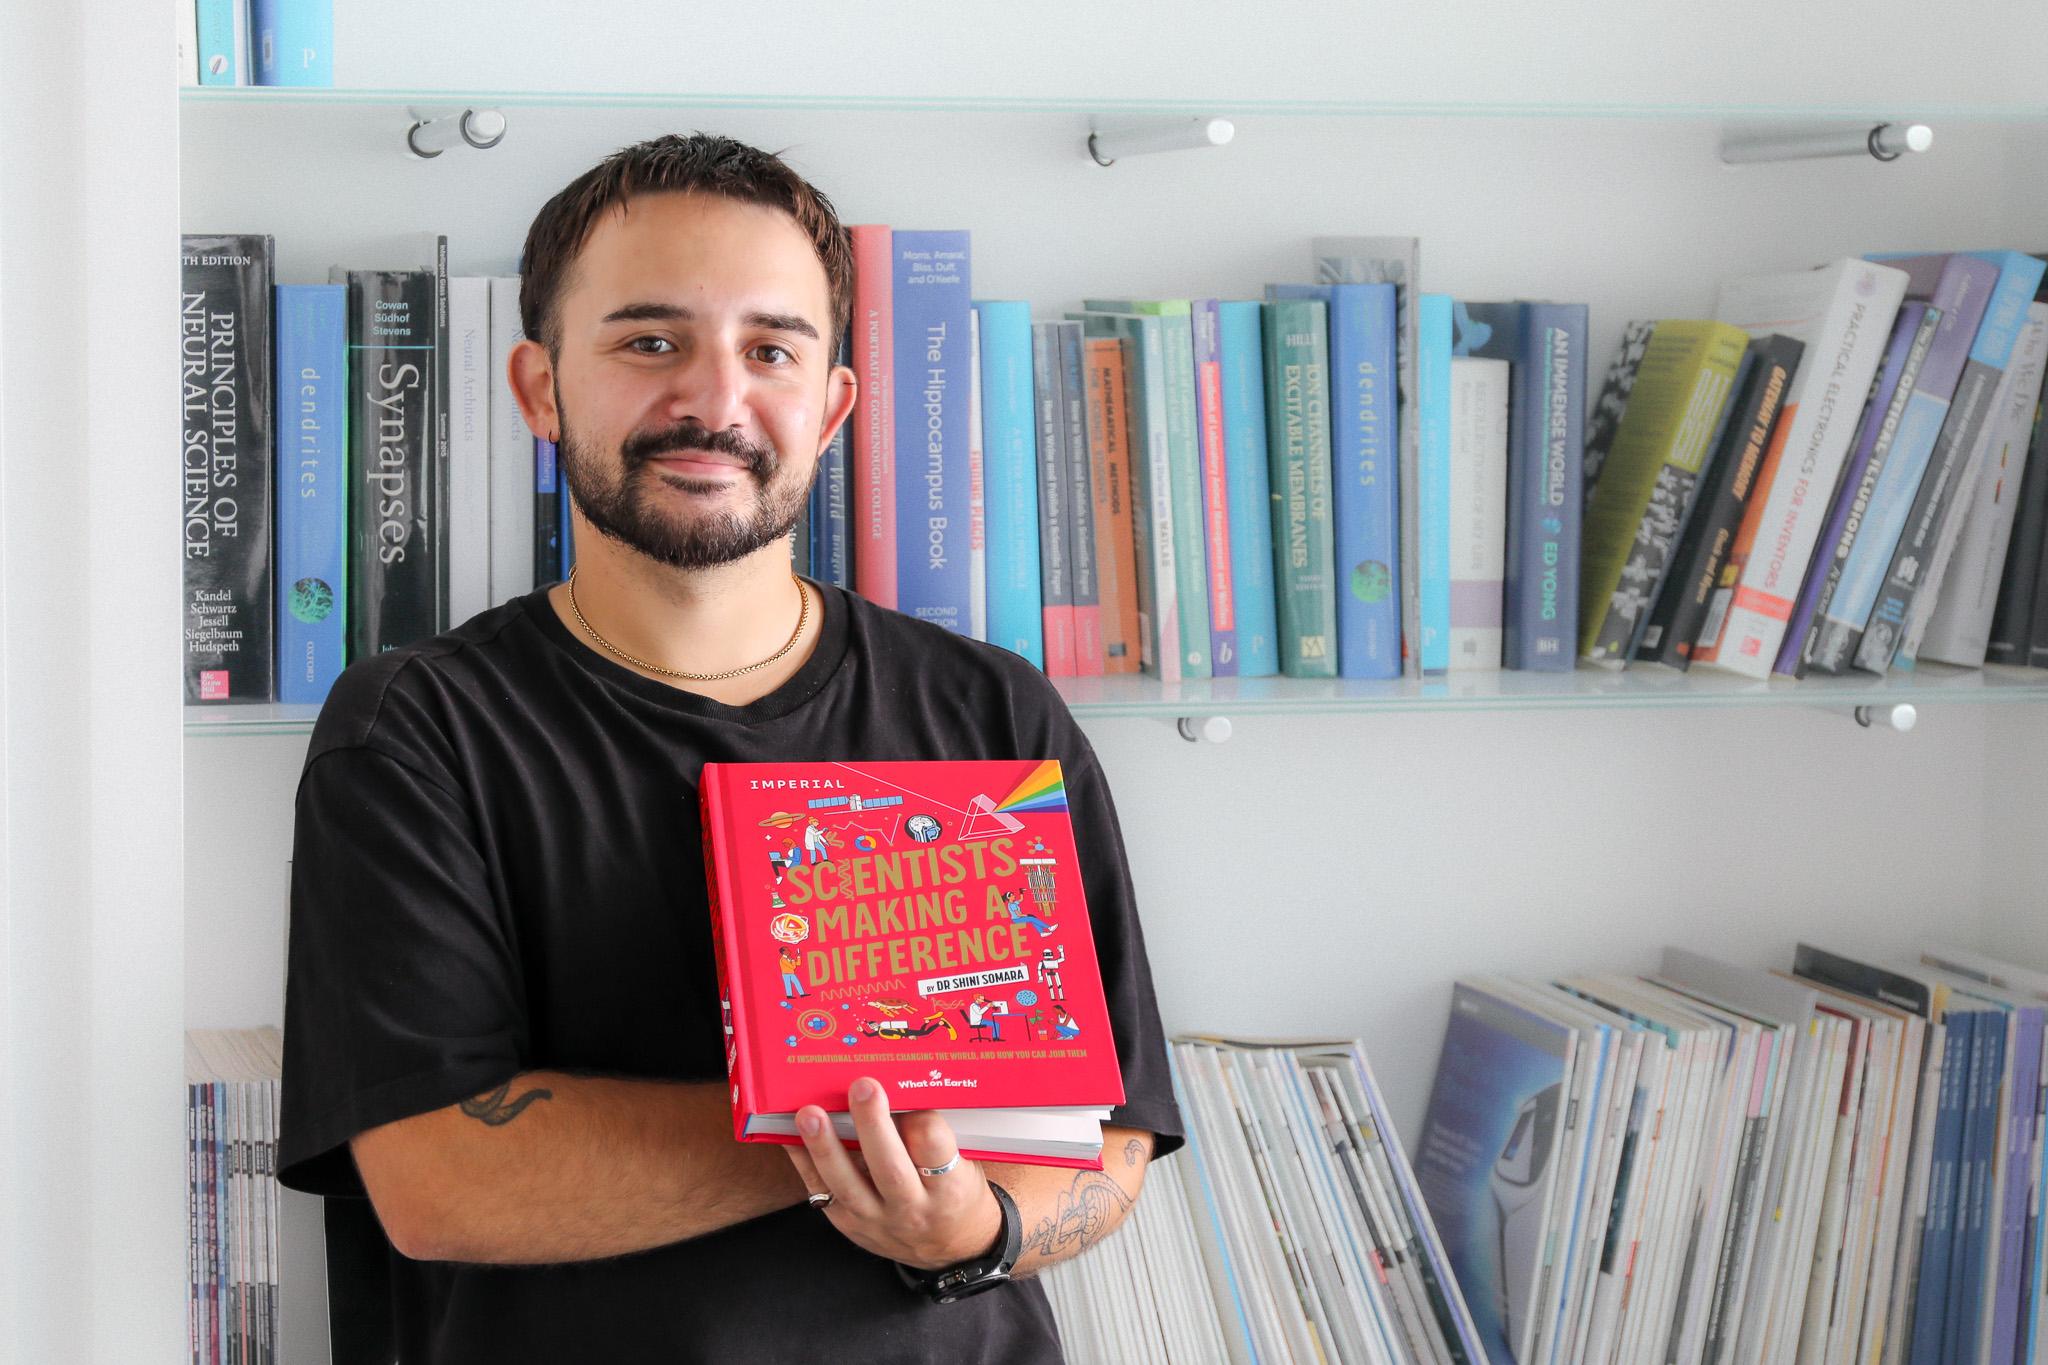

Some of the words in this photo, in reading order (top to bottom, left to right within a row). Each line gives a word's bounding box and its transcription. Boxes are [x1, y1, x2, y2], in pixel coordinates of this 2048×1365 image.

[202, 256, 251, 266] EDITION
[373, 327, 411, 336] Stevens
[374, 300, 409, 310] Cowan
[374, 313, 410, 323] Südhof
[182, 291, 207, 420] NEURAL
[463, 329, 475, 371] Neural
[869, 320, 879, 378] PORTRAIT
[926, 321, 947, 362] The
[1553, 327, 1570, 355] AN
[1832, 302, 1866, 379] PRACTICAL
[211, 312, 237, 487] PRINCIPLES
[871, 382, 880, 396] OF
[1306, 364, 1323, 395] ION
[1552, 358, 1569, 438] IMMENSE
[1756, 365, 1787, 428] GATEWAY
[301, 368, 320, 498] dendrites
[463, 376, 476, 441] Architects
[1104, 367, 1117, 453] MATHEMATICAL
[1285, 364, 1304, 456] EXCITABLE
[1358, 361, 1379, 486] dendrites
[1751, 425, 1767, 445] TO
[1800, 382, 1841, 475] ELECTRONICS
[1877, 371, 1914, 452] OPTICAL
[367, 363, 420, 564] Synapses
[542, 441, 553, 485] aitenberg
[871, 400, 881, 484] GOODENOUGH
[923, 368, 947, 510] Hippocampus
[1307, 399, 1325, 494] CHANNELS
[184, 429, 209, 559] SCIENCE
[829, 467, 845, 520] World
[1110, 462, 1121, 514] METHODS
[1550, 440, 1566, 506] WORLD
[1732, 441, 1760, 501] MEMORY
[1792, 479, 1809, 506] FOR
[214, 497, 238, 537] OF
[872, 487, 882, 540] COLLEGE
[1289, 460, 1308, 569] MEMBRANES
[1311, 498, 1327, 521] OF
[1835, 455, 1883, 560] ILLUSIONS
[929, 517, 948, 570] Book
[1543, 542, 1558, 566] ED
[1765, 509, 1799, 588] INVENTORS
[190, 603, 237, 614] Schwartz
[195, 590, 232, 602] Kandel
[915, 606, 958, 617] SECOND
[1541, 568, 1557, 620] YONG
[185, 628, 243, 641] Siegelbaum
[189, 640, 239, 654] Hudspeth
[199, 615, 229, 627] Jessell
[750, 779, 845, 790] IMPERIAL
[787, 838, 1017, 905] SCIENTISTS
[815, 889, 968, 944] MAKING
[985, 885, 1009, 921] A
[806, 922, 1032, 987] DIFFERENCE
[926, 985, 935, 993] BY
[936, 979, 951, 992] DR
[952, 975, 981, 989] SHINI
[982, 971, 1026, 986] SOMARA
[797, 1054, 852, 1063] INSPIRATIONAL
[855, 1053, 895, 1062] SCIENTISTS
[896, 1052, 934, 1061] CHANGING
[935, 1052, 950, 1060] THE
[980, 1051, 995, 1060] AND
[997, 1050, 1014, 1059] HOW
[1015, 1050, 1031, 1059] YOU
[1032, 1050, 1047, 1059] CAN
[1048, 1050, 1066, 1059] JOIN
[1067, 1049, 1087, 1058] THEM
[898, 1080, 928, 1089] What
[944, 1078, 978, 1088] Earth!
